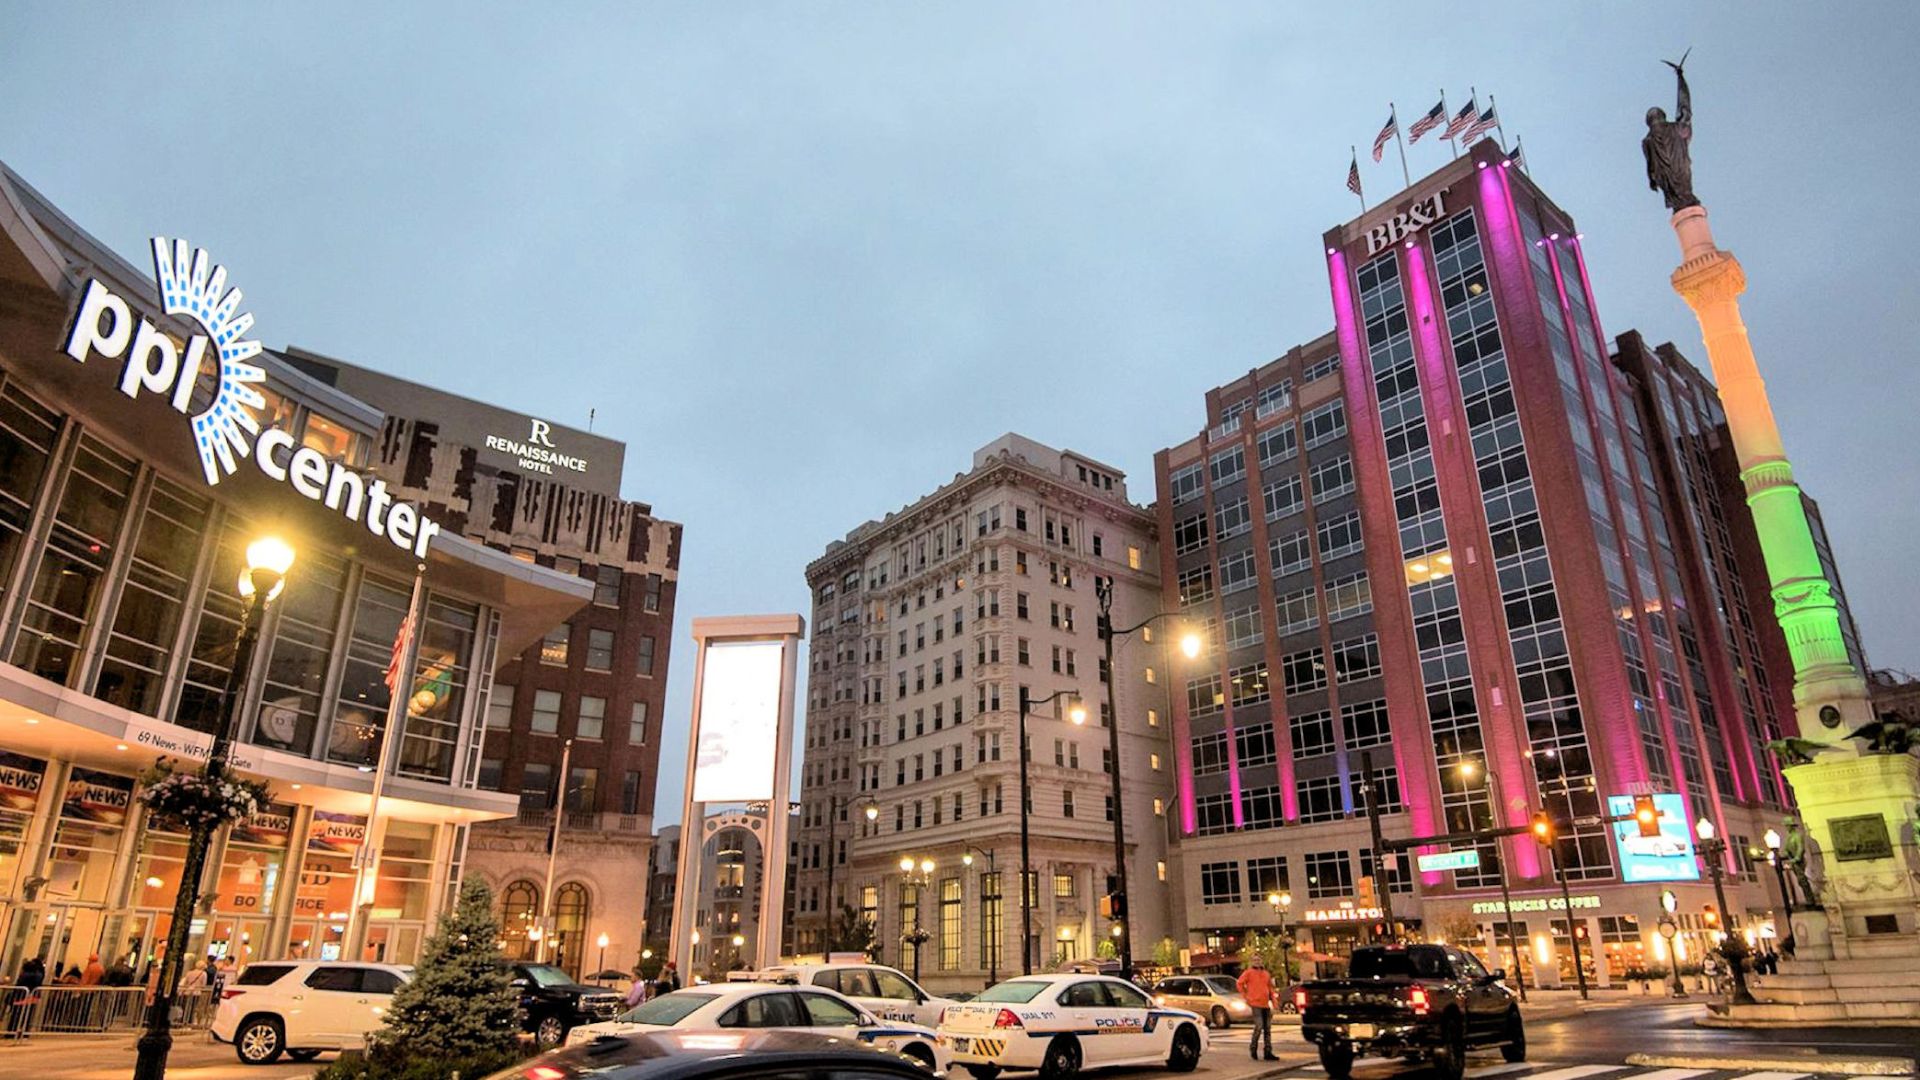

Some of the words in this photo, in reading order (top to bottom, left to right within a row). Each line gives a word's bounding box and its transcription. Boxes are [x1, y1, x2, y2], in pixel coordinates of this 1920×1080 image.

[1364, 187, 1451, 256] BB&T
[65, 278, 209, 414] ppl
[528, 419, 556, 448] R
[486, 435, 588, 472] RENAISSANCE
[518, 458, 553, 475] HOTEL
[255, 428, 439, 560] center
[137, 731, 151, 744] 69
[152, 734, 177, 751] News
[0, 770, 39, 790] NEWS
[84, 785, 127, 806] NEWS
[249, 815, 289, 831] NEWS
[327, 825, 365, 839] NEWS
[233, 895, 256, 907] BO
[1021, 1012, 1040, 1020] DIAL
[1041, 1011, 1056, 1019] 911
[1095, 1017, 1142, 1027] POLICE
